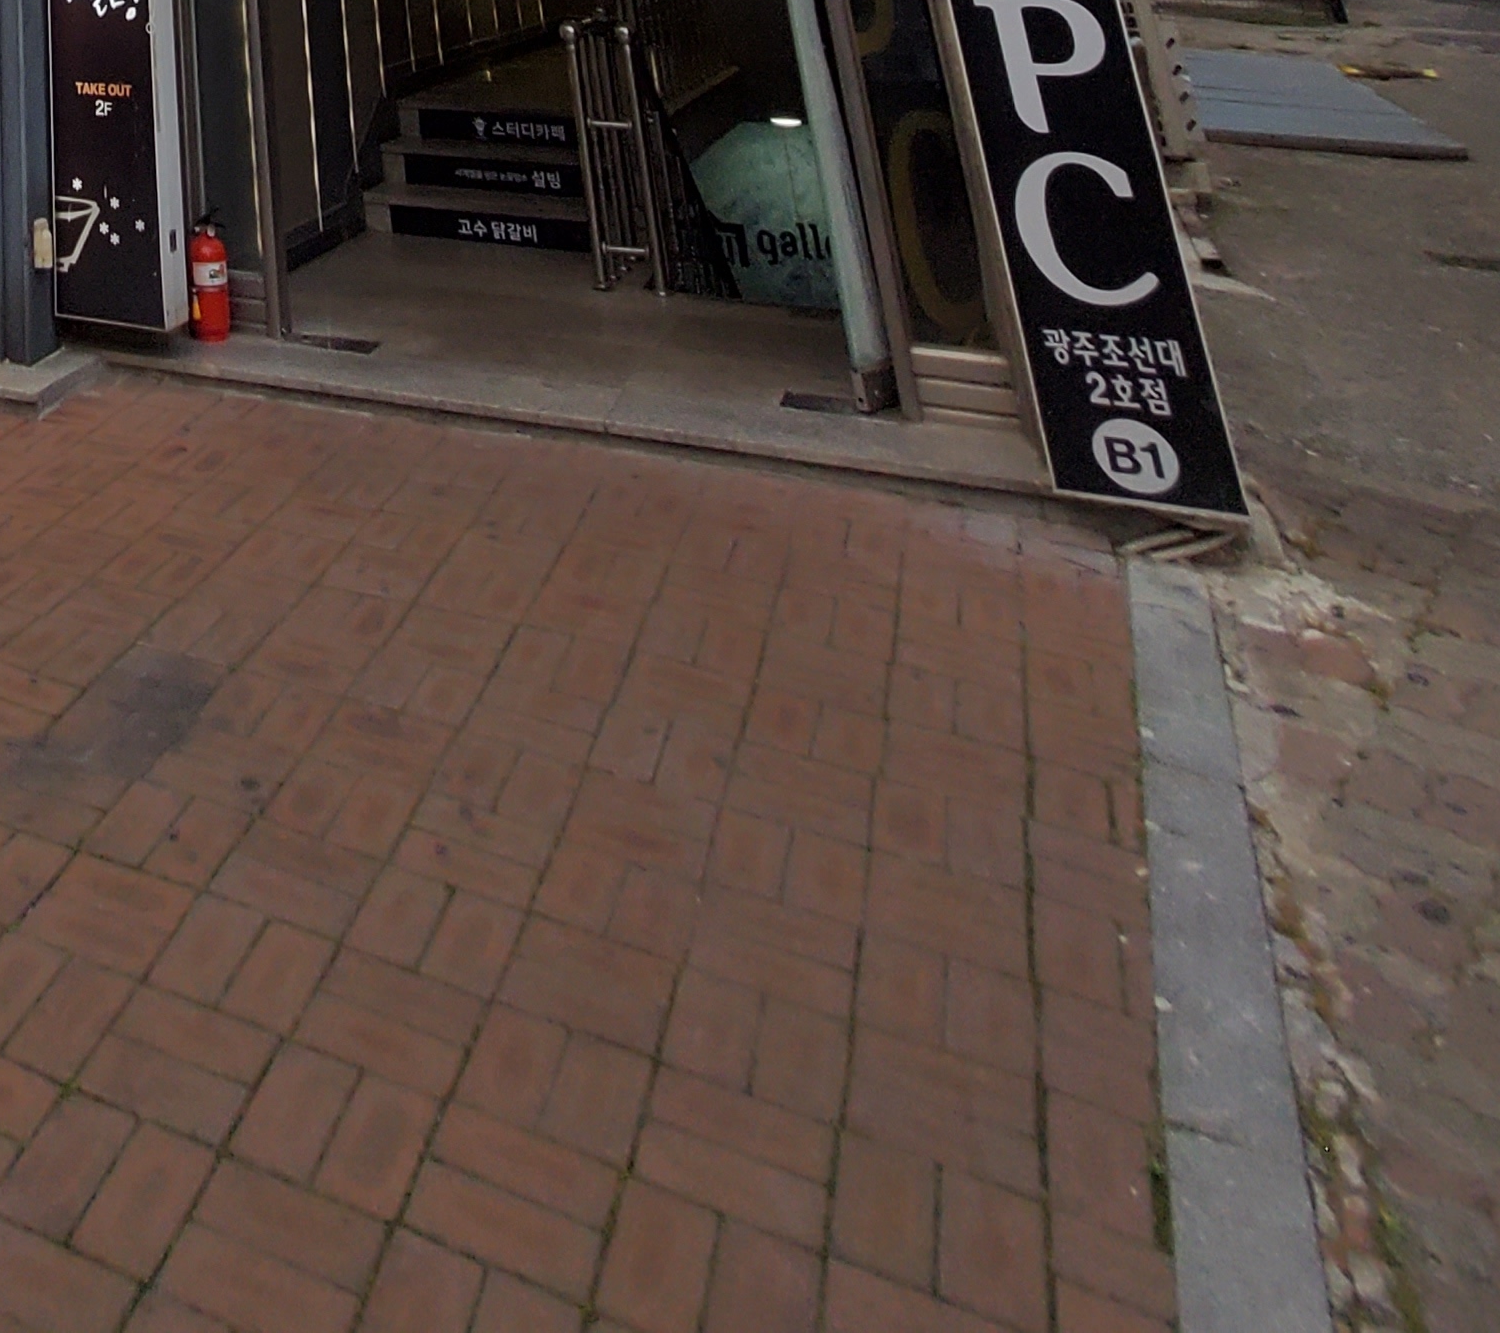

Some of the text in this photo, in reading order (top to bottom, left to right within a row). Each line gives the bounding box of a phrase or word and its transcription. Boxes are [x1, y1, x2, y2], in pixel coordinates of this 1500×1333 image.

[75, 82, 133, 97] TAKE OUT
[95, 100, 113, 116] 2F
[458, 218, 538, 243] 고수 닭갈비
[1042, 329, 1187, 377] 광주조선대
[1085, 371, 1171, 416] 2호점
[1104, 436, 1165, 479] B1
